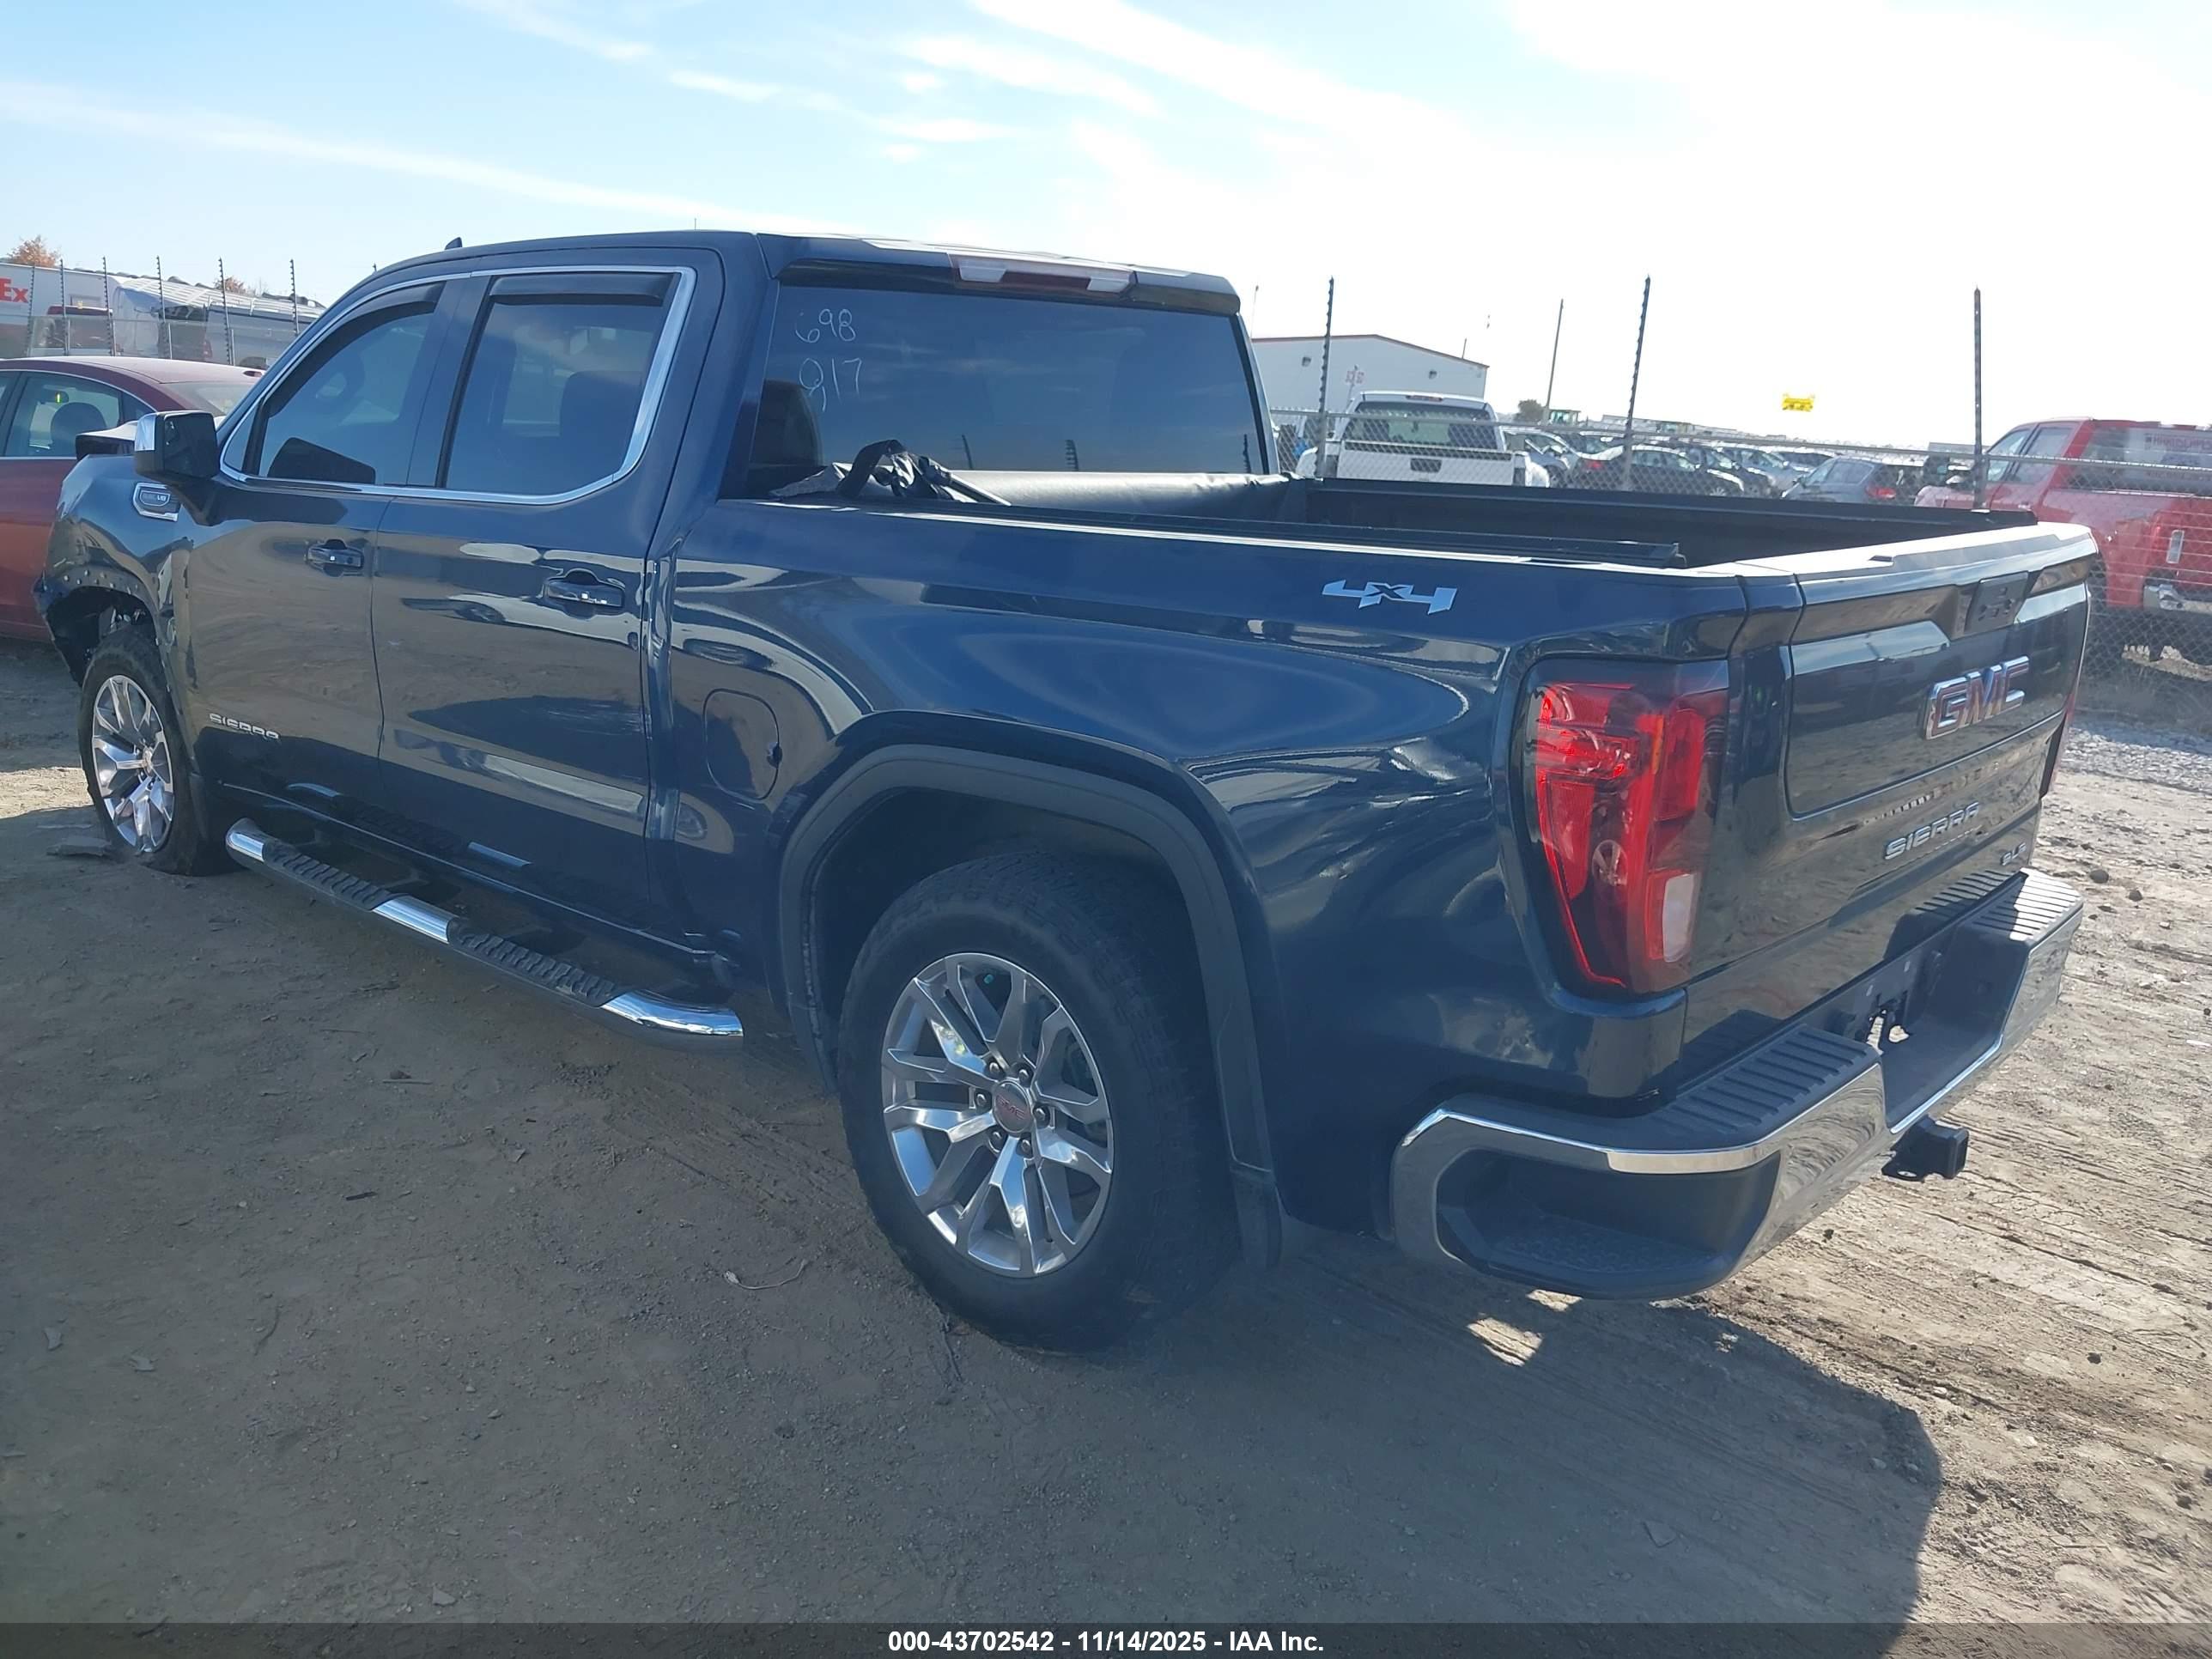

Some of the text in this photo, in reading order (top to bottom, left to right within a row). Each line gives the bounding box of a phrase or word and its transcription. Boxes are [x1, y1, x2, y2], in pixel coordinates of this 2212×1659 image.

[209, 713, 279, 739] SIERRA
[1925, 655, 2029, 739] GMC
[1884, 801, 1979, 860] SIERRA
